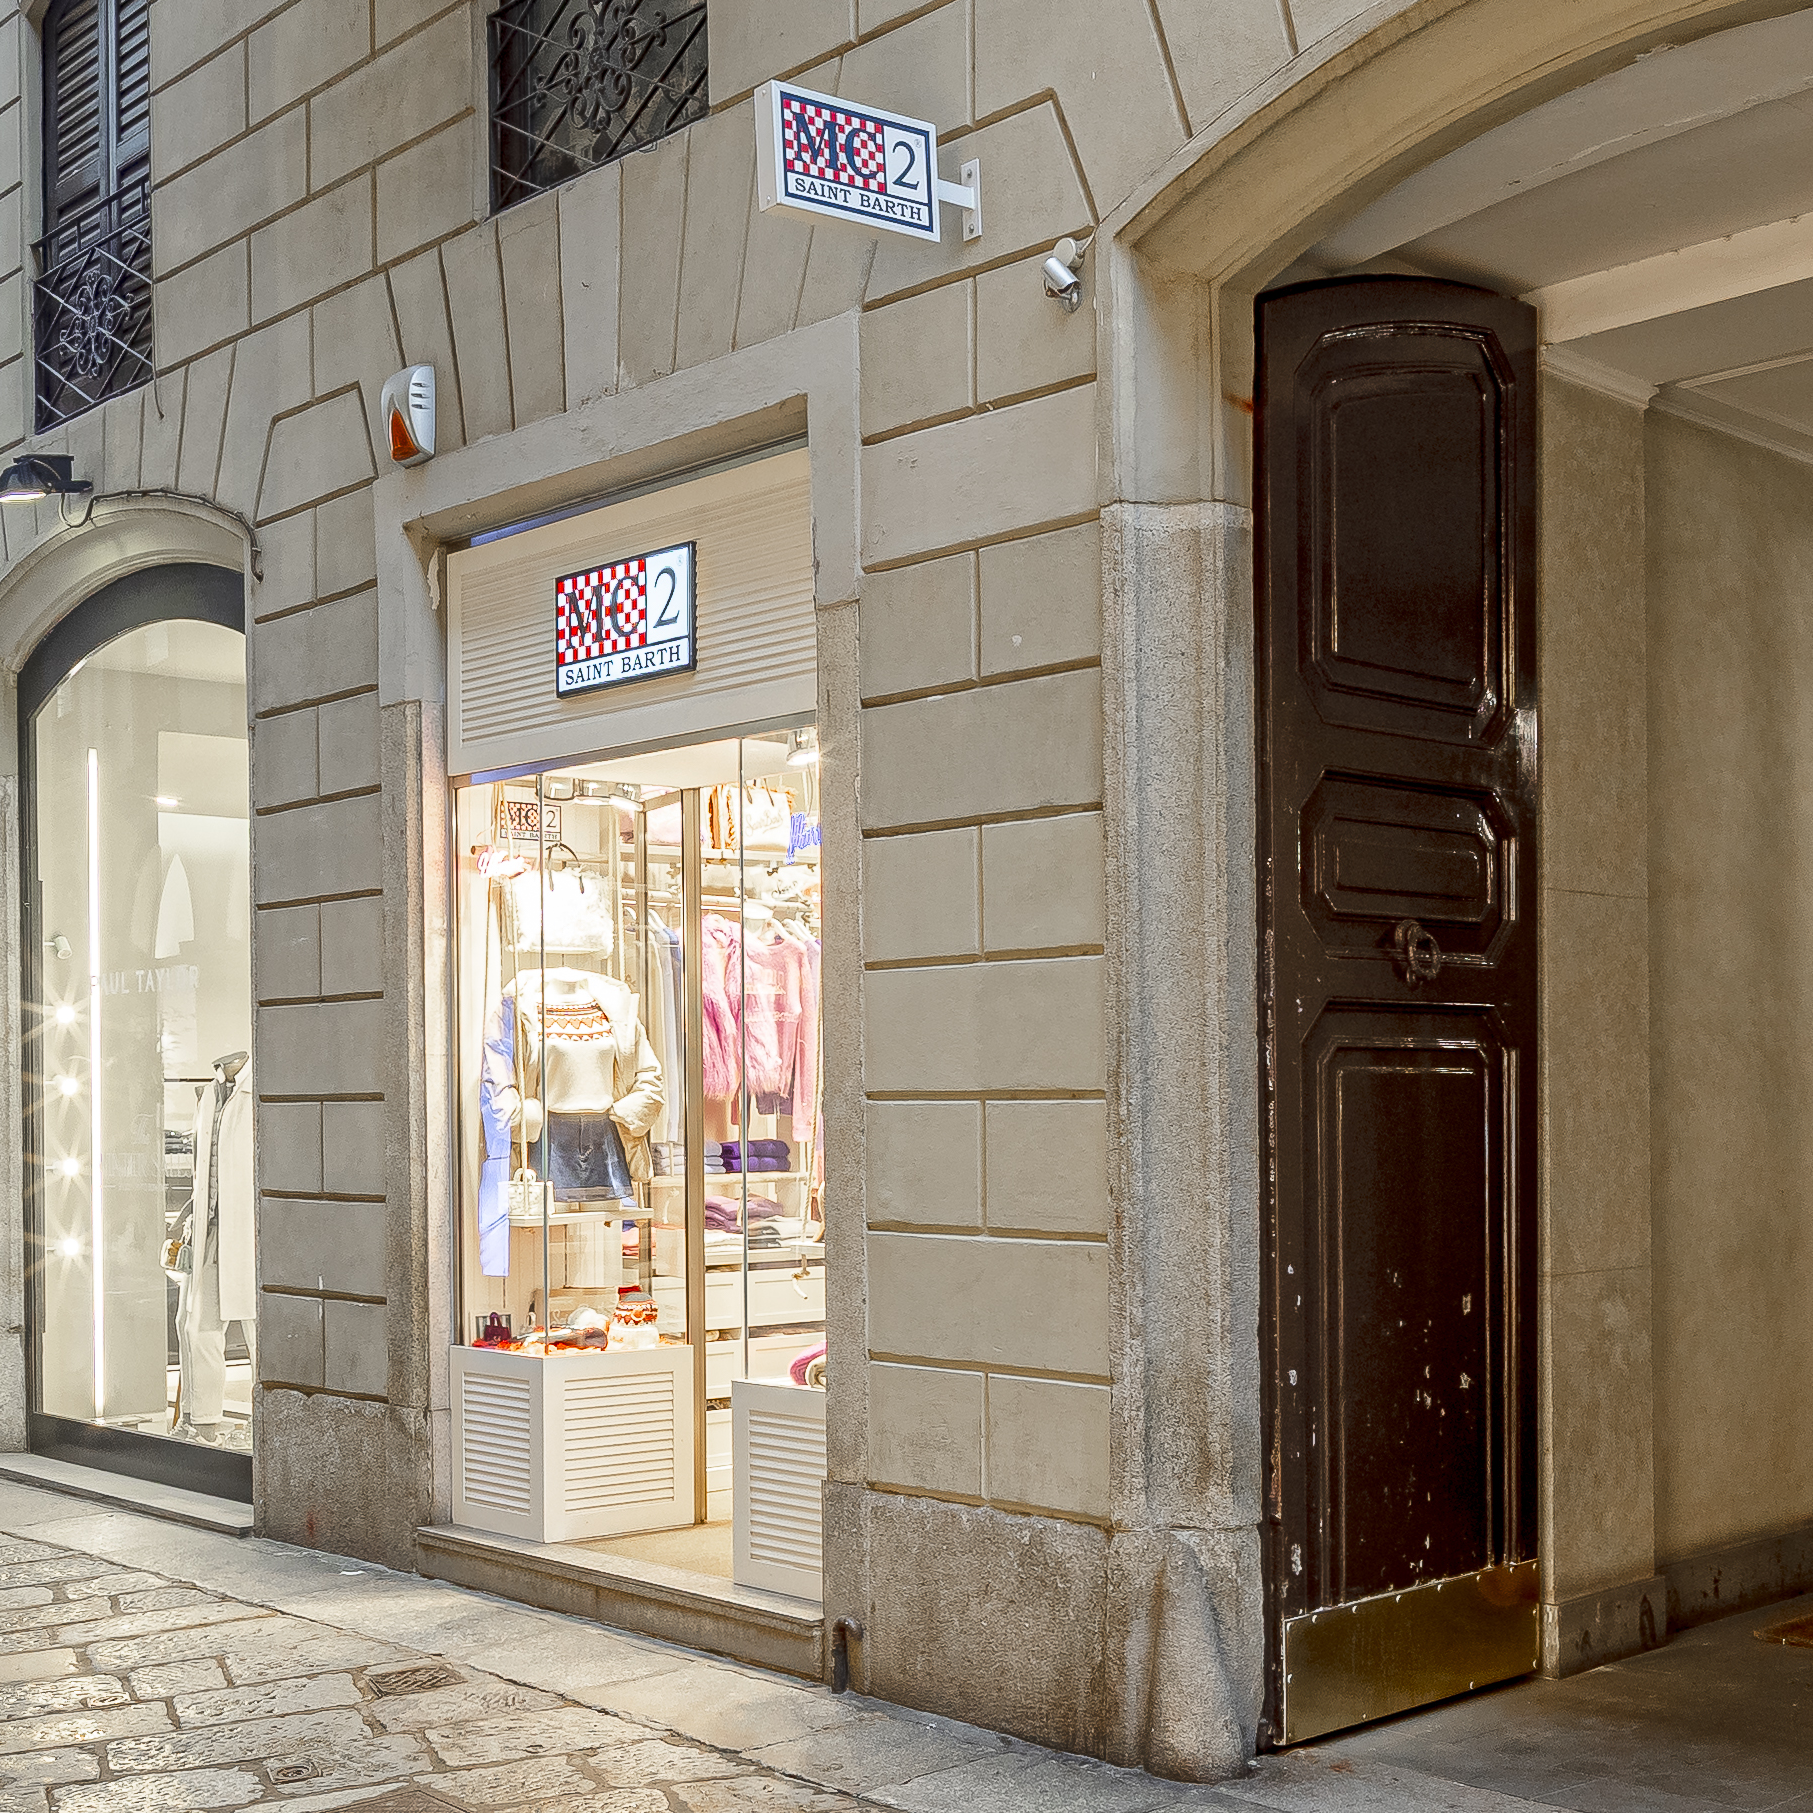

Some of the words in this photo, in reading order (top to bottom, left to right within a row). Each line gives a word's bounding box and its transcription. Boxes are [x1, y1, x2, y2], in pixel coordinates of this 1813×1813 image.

[794, 177, 852, 204] SAINT
[859, 192, 923, 222] BARTH
[565, 660, 614, 686] SAINT
[621, 644, 681, 674] BARTH
